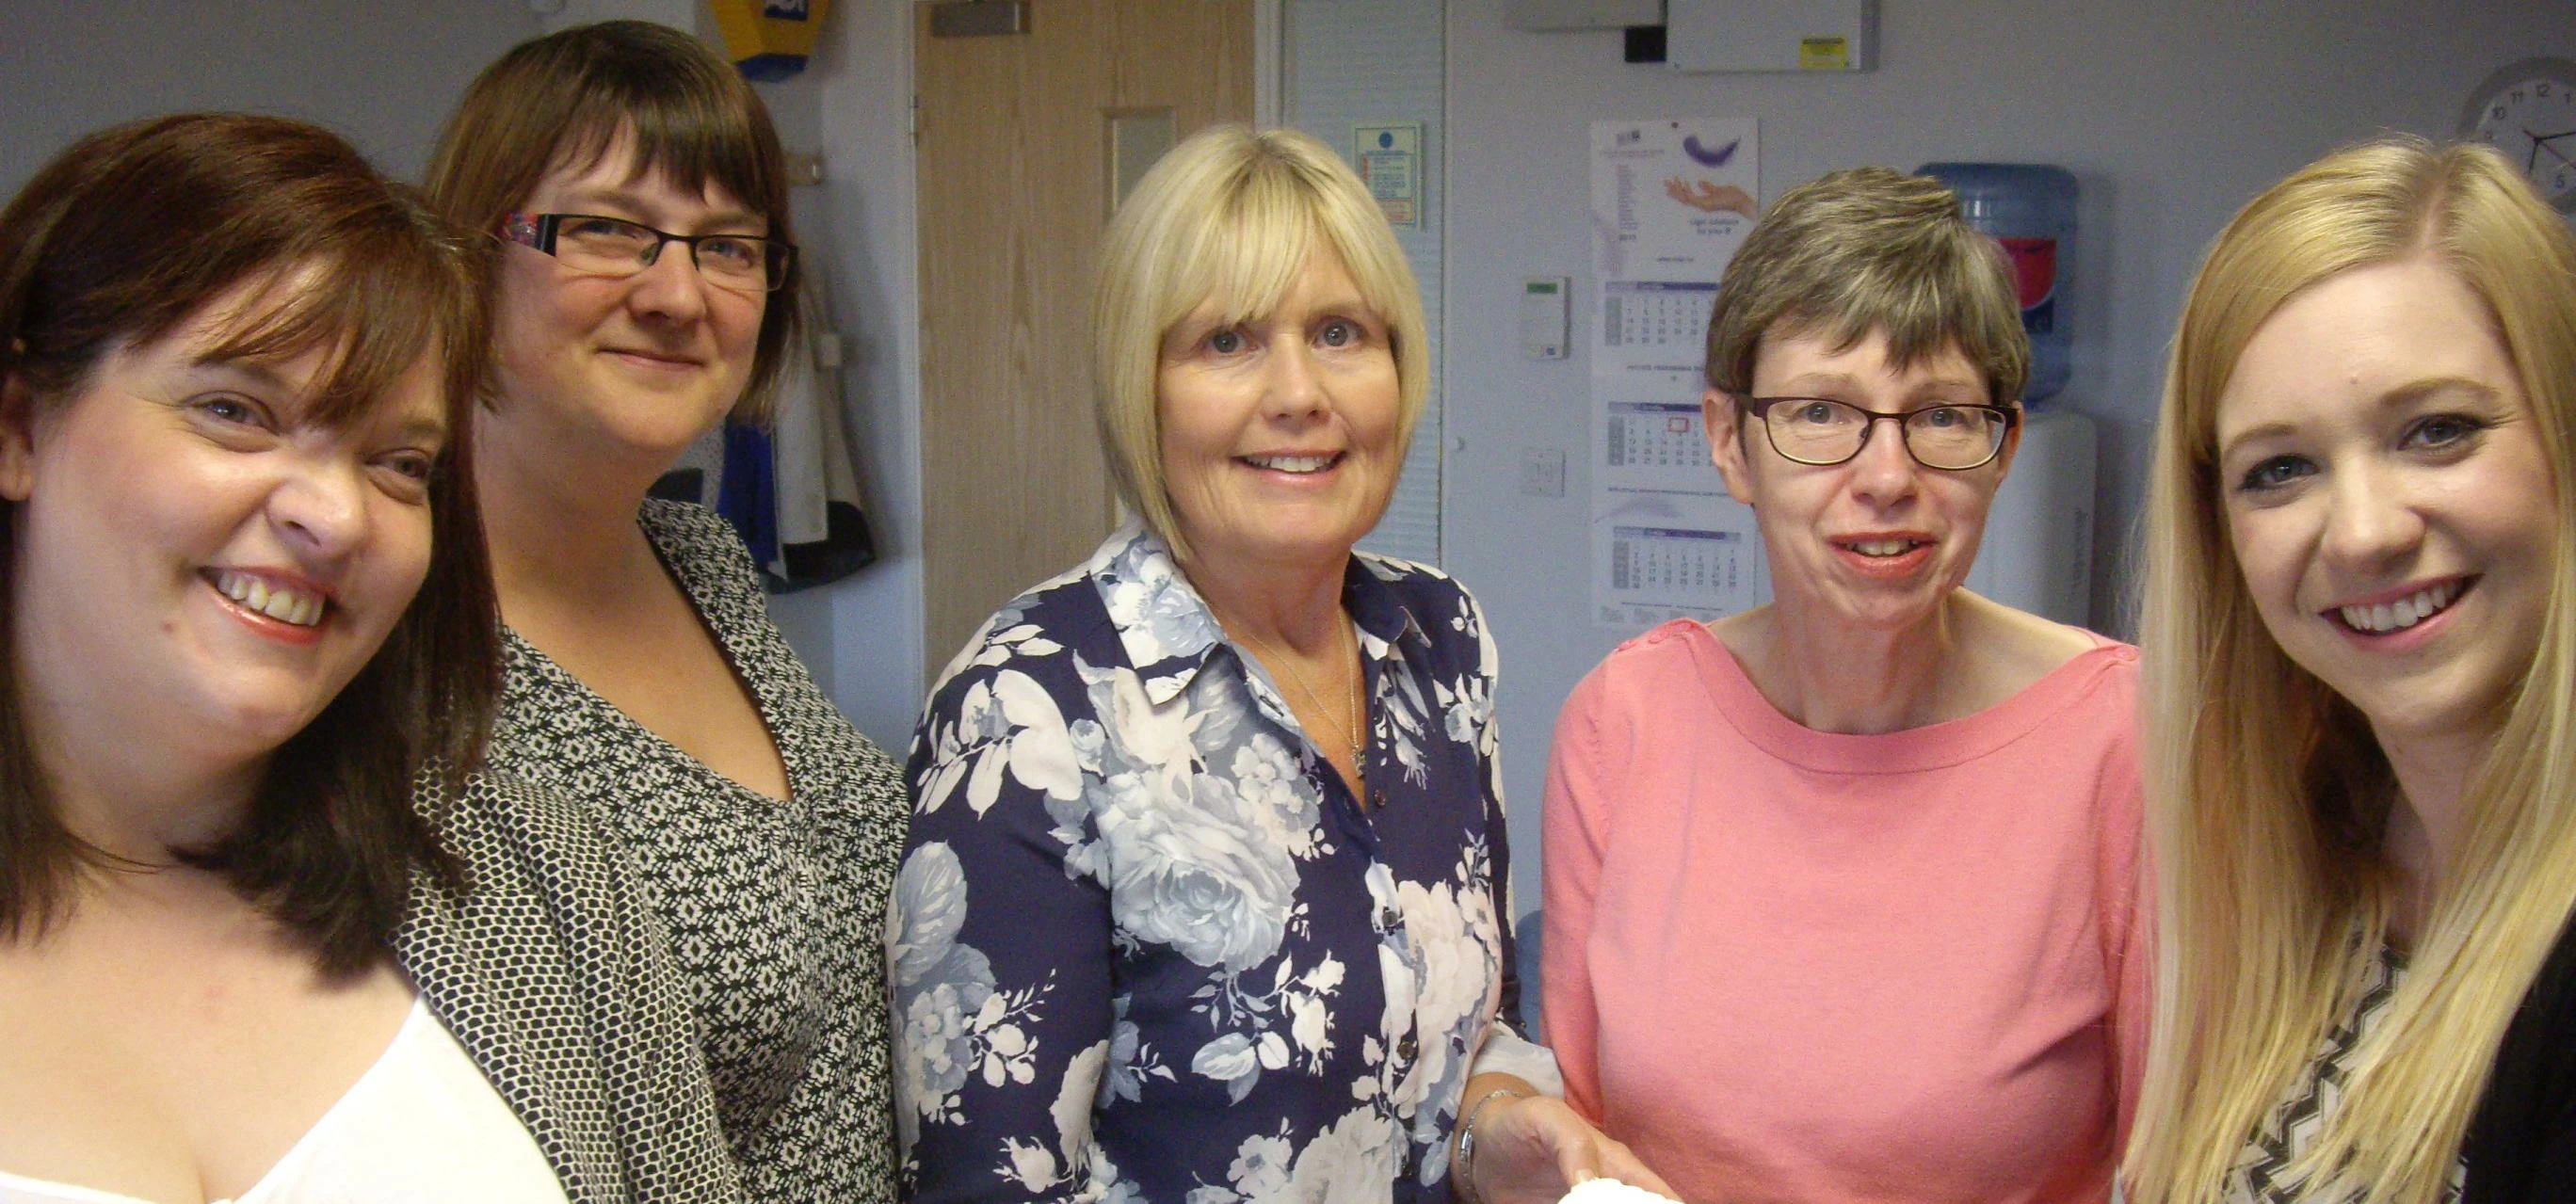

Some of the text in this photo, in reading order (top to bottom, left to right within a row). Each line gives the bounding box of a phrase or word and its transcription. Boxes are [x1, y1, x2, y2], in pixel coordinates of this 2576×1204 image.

[2511, 90, 2523, 104] 11
[2536, 83, 2551, 97] 12
[2564, 93, 2571, 104] 1
